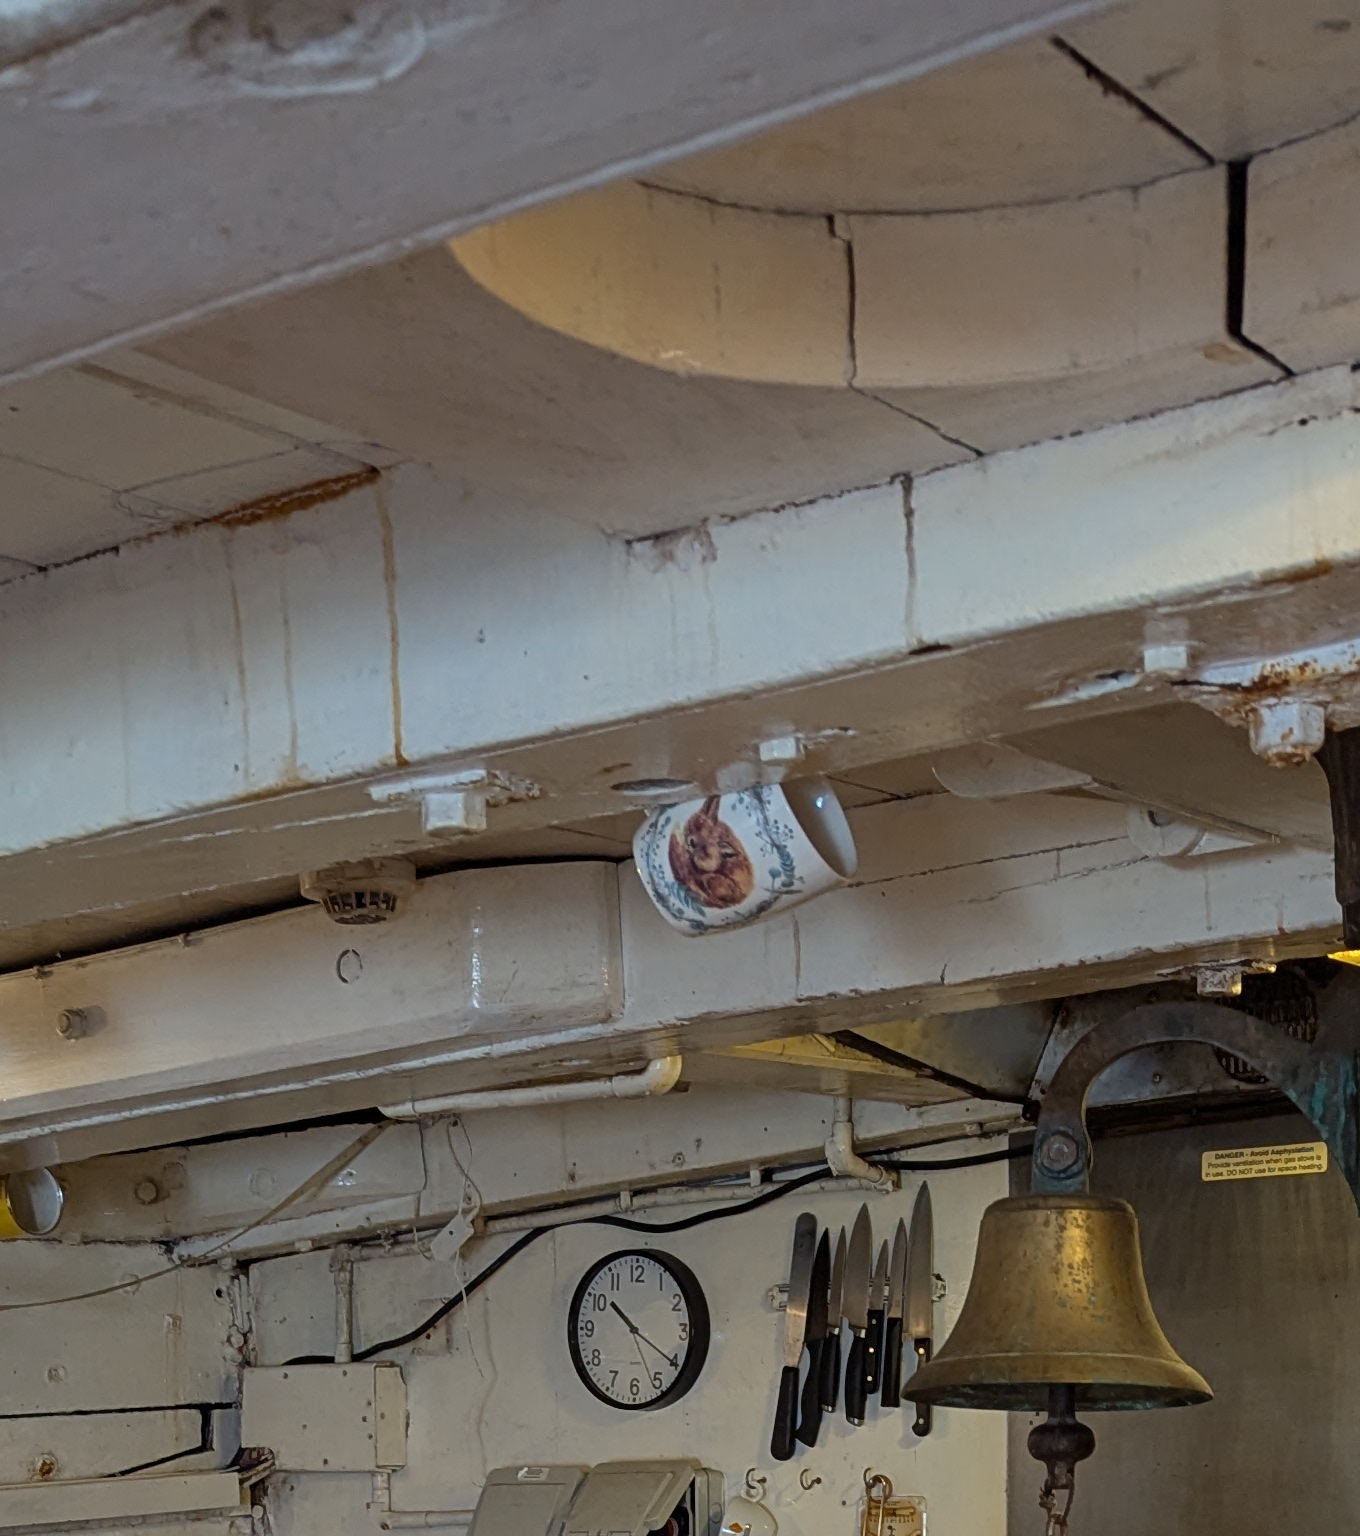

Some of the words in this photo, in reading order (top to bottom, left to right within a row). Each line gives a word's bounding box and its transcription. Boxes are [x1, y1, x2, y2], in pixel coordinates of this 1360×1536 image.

[1215, 1151, 1245, 1160] DANGER
[610, 1273, 620, 1292] 11
[630, 1264, 645, 1283] 12
[592, 1293, 607, 1312] 10
[671, 1293, 682, 1312] 2
[584, 1320, 595, 1338] 9
[678, 1322, 688, 1341] 3
[591, 1349, 601, 1367] 8
[669, 1353, 679, 1370] 4
[609, 1369, 619, 1388] 7
[630, 1378, 640, 1396] 6
[652, 1371, 663, 1390] 5
